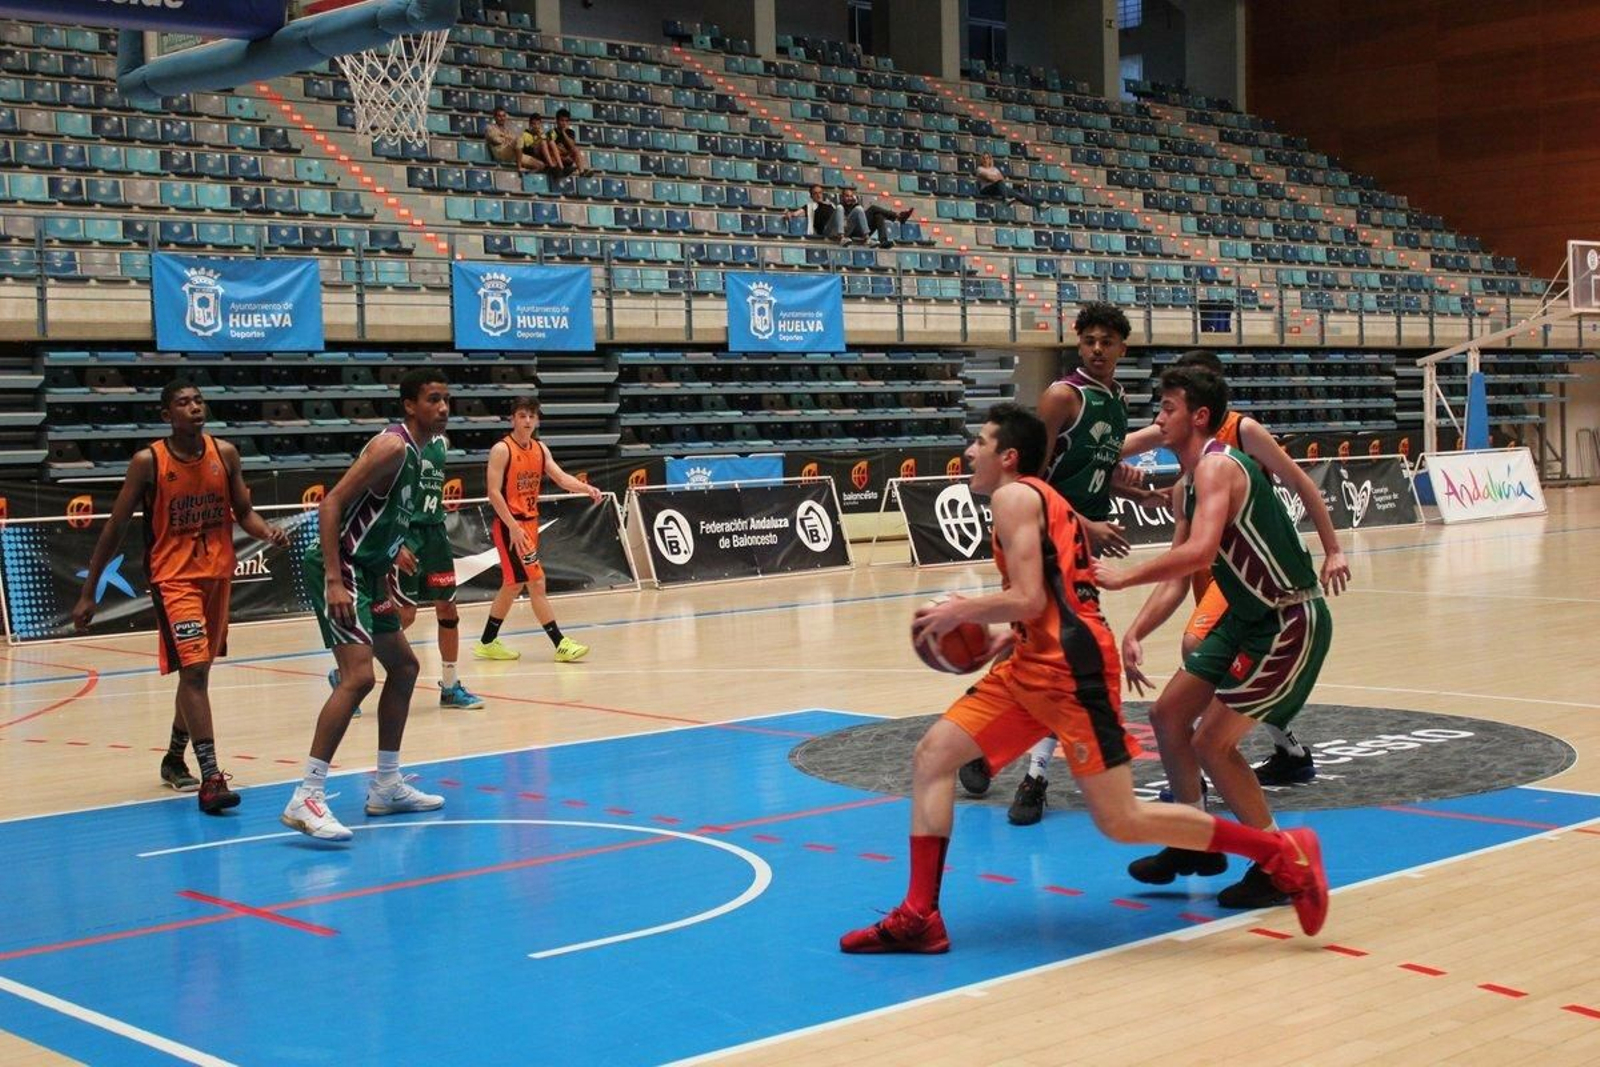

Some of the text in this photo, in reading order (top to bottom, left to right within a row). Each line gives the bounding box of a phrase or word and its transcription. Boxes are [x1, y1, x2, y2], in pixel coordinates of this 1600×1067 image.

[283, 302, 293, 310] de
[229, 313, 292, 327] HUELVA
[516, 316, 569, 329] HUELVA
[778, 320, 824, 332] HUELVA
[230, 330, 265, 338] Deportes
[1088, 469, 1105, 493] 19
[424, 495, 438, 514] 14
[700, 516, 789, 534] Federación Andaluza
[719, 532, 777, 549] de Baloncesto
[234, 549, 271, 577] ank
